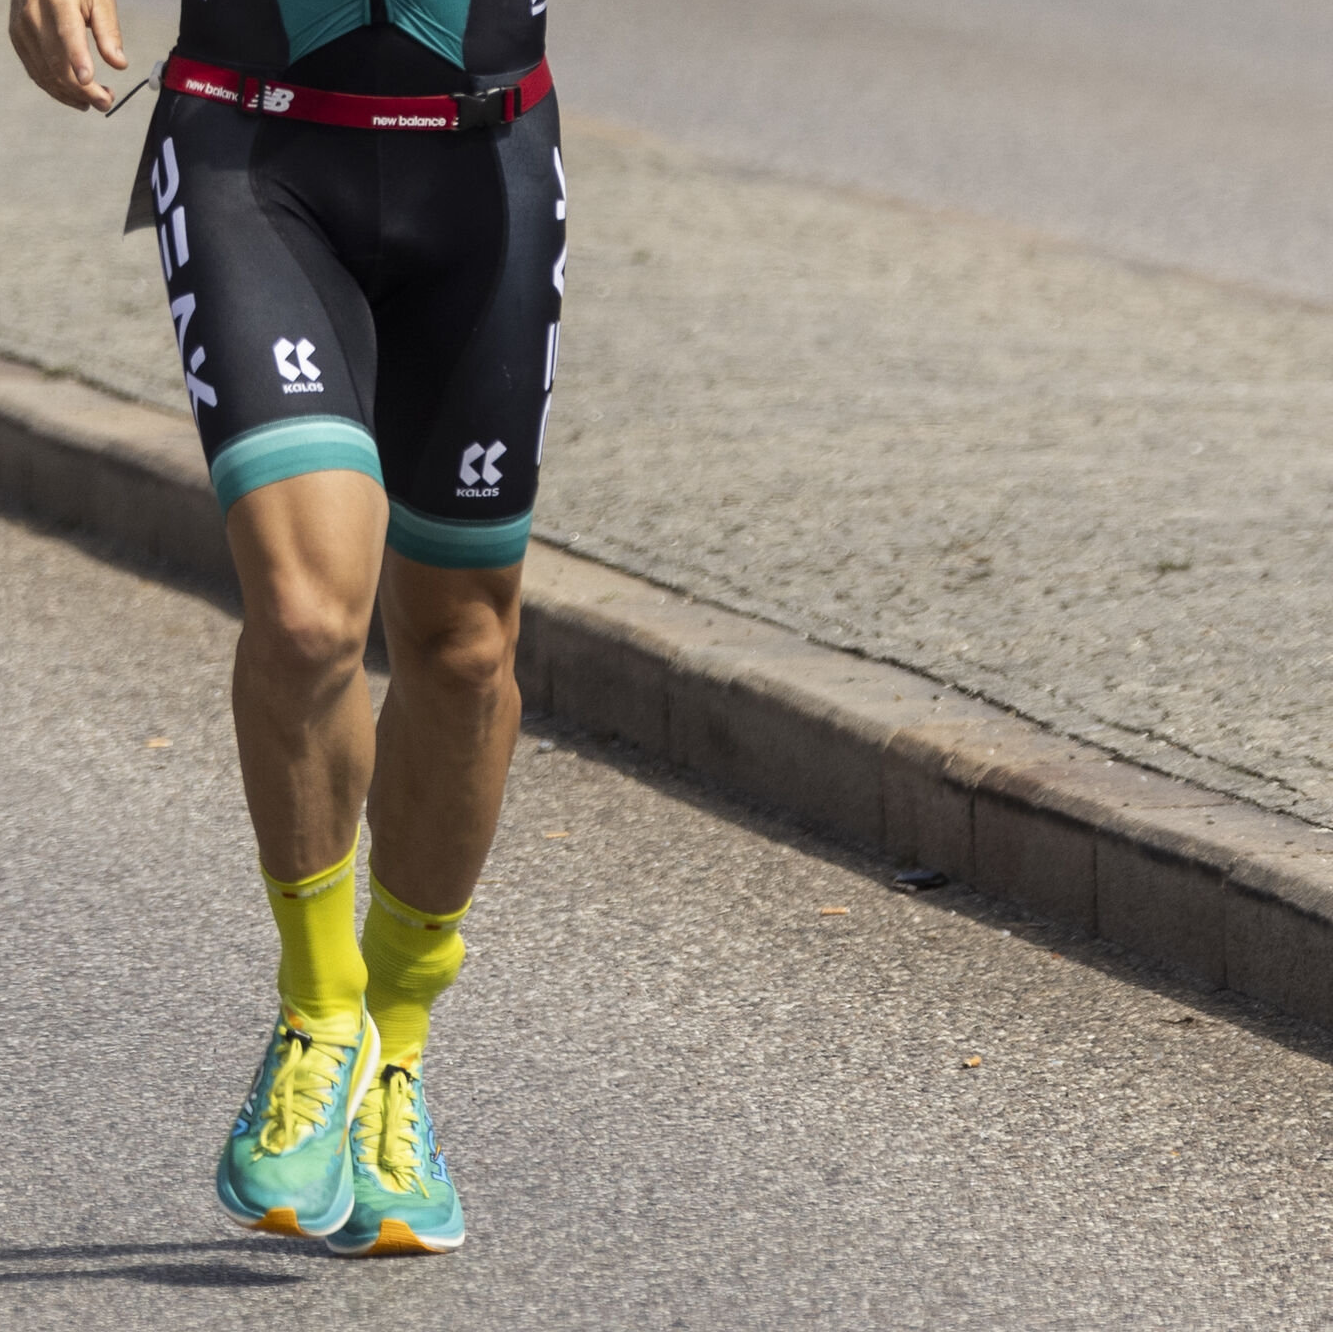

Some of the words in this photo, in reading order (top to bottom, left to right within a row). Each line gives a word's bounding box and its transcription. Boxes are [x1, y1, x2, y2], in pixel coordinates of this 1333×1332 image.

[185, 78, 206, 93] new
[372, 115, 398, 126] new
[398, 114, 447, 127] balance
